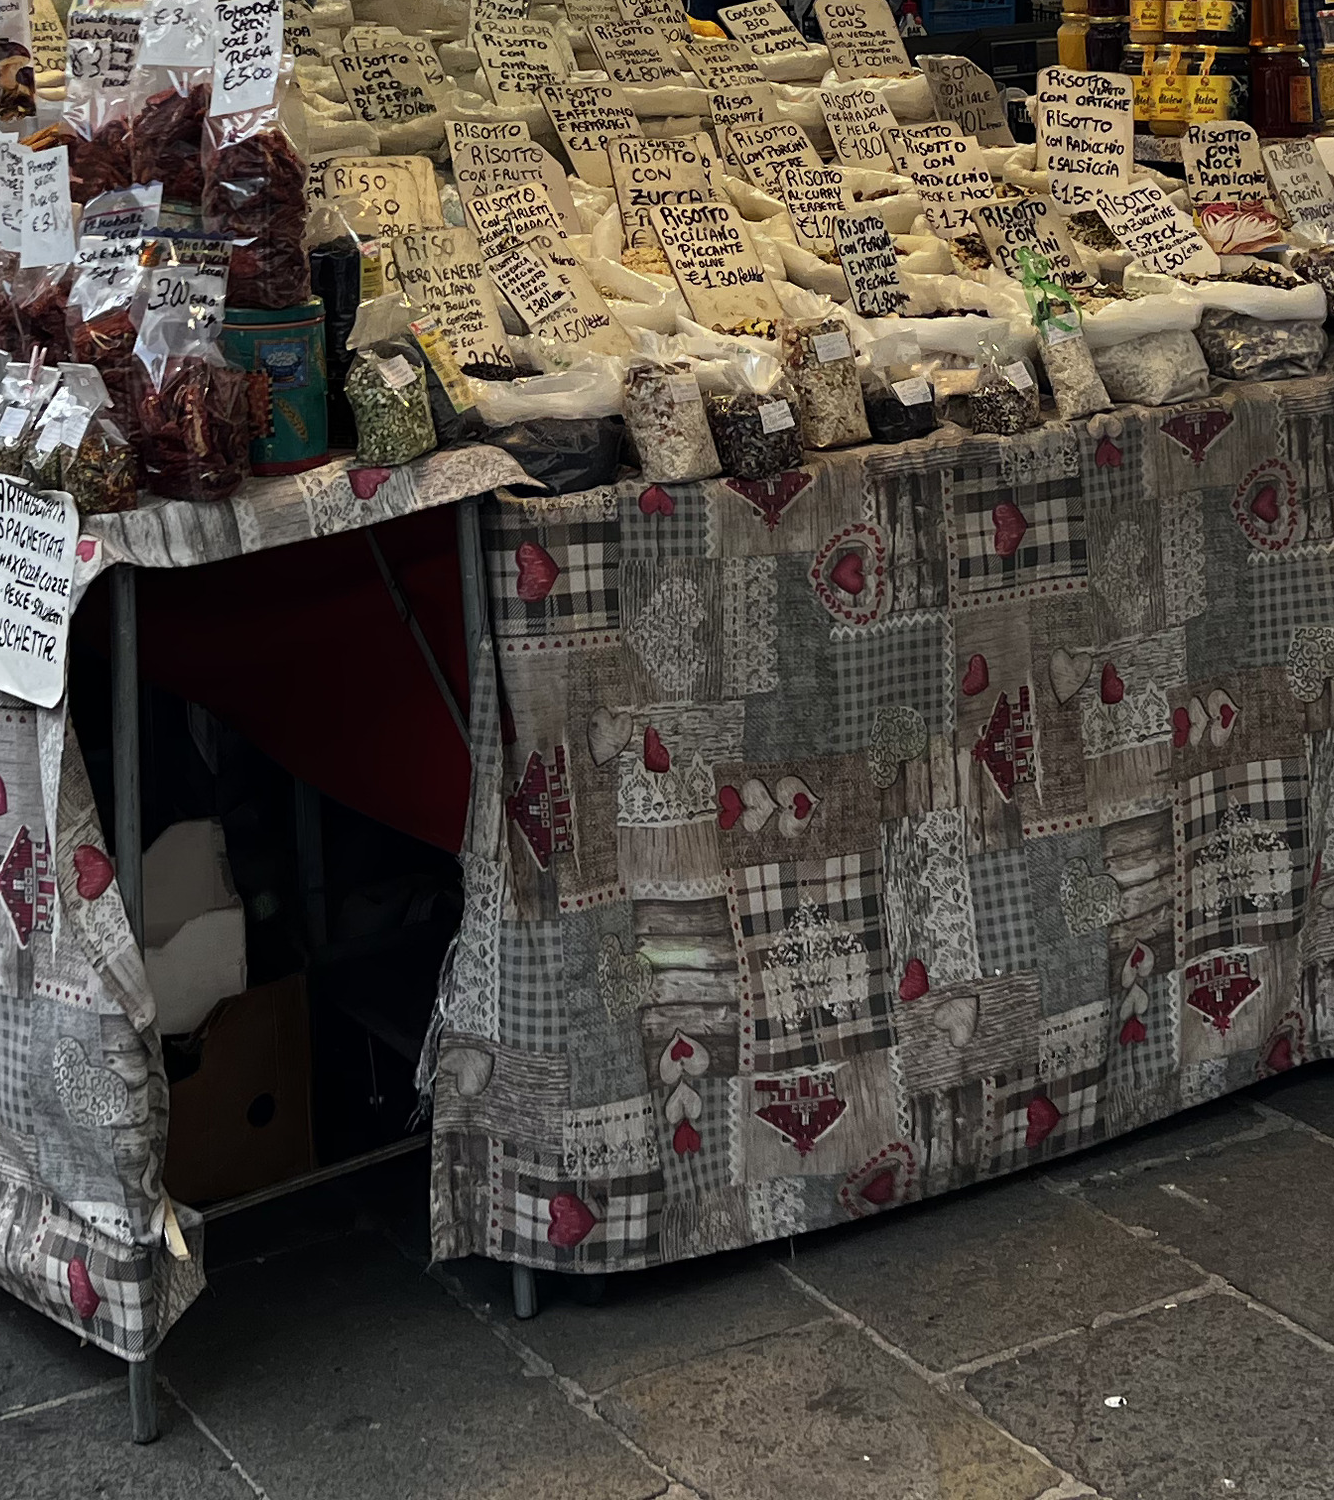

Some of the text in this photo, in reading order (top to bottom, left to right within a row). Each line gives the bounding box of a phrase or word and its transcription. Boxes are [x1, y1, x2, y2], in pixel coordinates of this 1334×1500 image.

[824, 3, 866, 18] COUS
[594, 25, 654, 41] RISOTTO
[829, 17, 867, 30] COUS
[482, 34, 548, 51] RISOTTO
[340, 54, 409, 74] RISOTTO
[1046, 70, 1112, 88] RISOTTO
[352, 81, 401, 97] NERO
[544, 86, 612, 104] RISOTTO
[713, 92, 753, 111] RISO
[820, 91, 876, 110] RISOTTO
[1076, 95, 1131, 111] ORTICHE
[552, 107, 634, 122] ZAFFERANO
[714, 107, 764, 125] BASMATI
[1046, 109, 1113, 133] RISOTTO
[454, 124, 521, 140] RISOTTO
[732, 125, 797, 149] RISOTTO
[1188, 125, 1251, 144] RISOTTO
[472, 146, 544, 166] RISOTTO
[619, 142, 696, 165] RISOTTO
[903, 138, 966, 156] RISOTTO
[1205, 143, 1240, 158] CON
[922, 154, 956, 169] CON
[1057, 157, 1119, 177] SALSICCIA
[1196, 156, 1242, 172] NOCI
[1268, 150, 1314, 171] RISOTTO
[334, 169, 386, 192] RISO
[632, 168, 671, 183] CON
[785, 168, 843, 188] RISOTTO
[911, 168, 989, 187] RADICCHIO
[961, 185, 995, 200] NOCI
[1097, 187, 1162, 218] RISOTTO
[660, 206, 729, 230] RISOTTO
[979, 200, 1047, 228] RISOTTO
[661, 227, 739, 247] SICILIANO
[838, 215, 884, 240] RISOTTO
[1005, 226, 1038, 245] CON
[403, 235, 456, 262] RISO
[677, 243, 744, 258] PICCANTE
[432, 262, 483, 283] VENERE
[422, 282, 476, 300] ITALIANO
